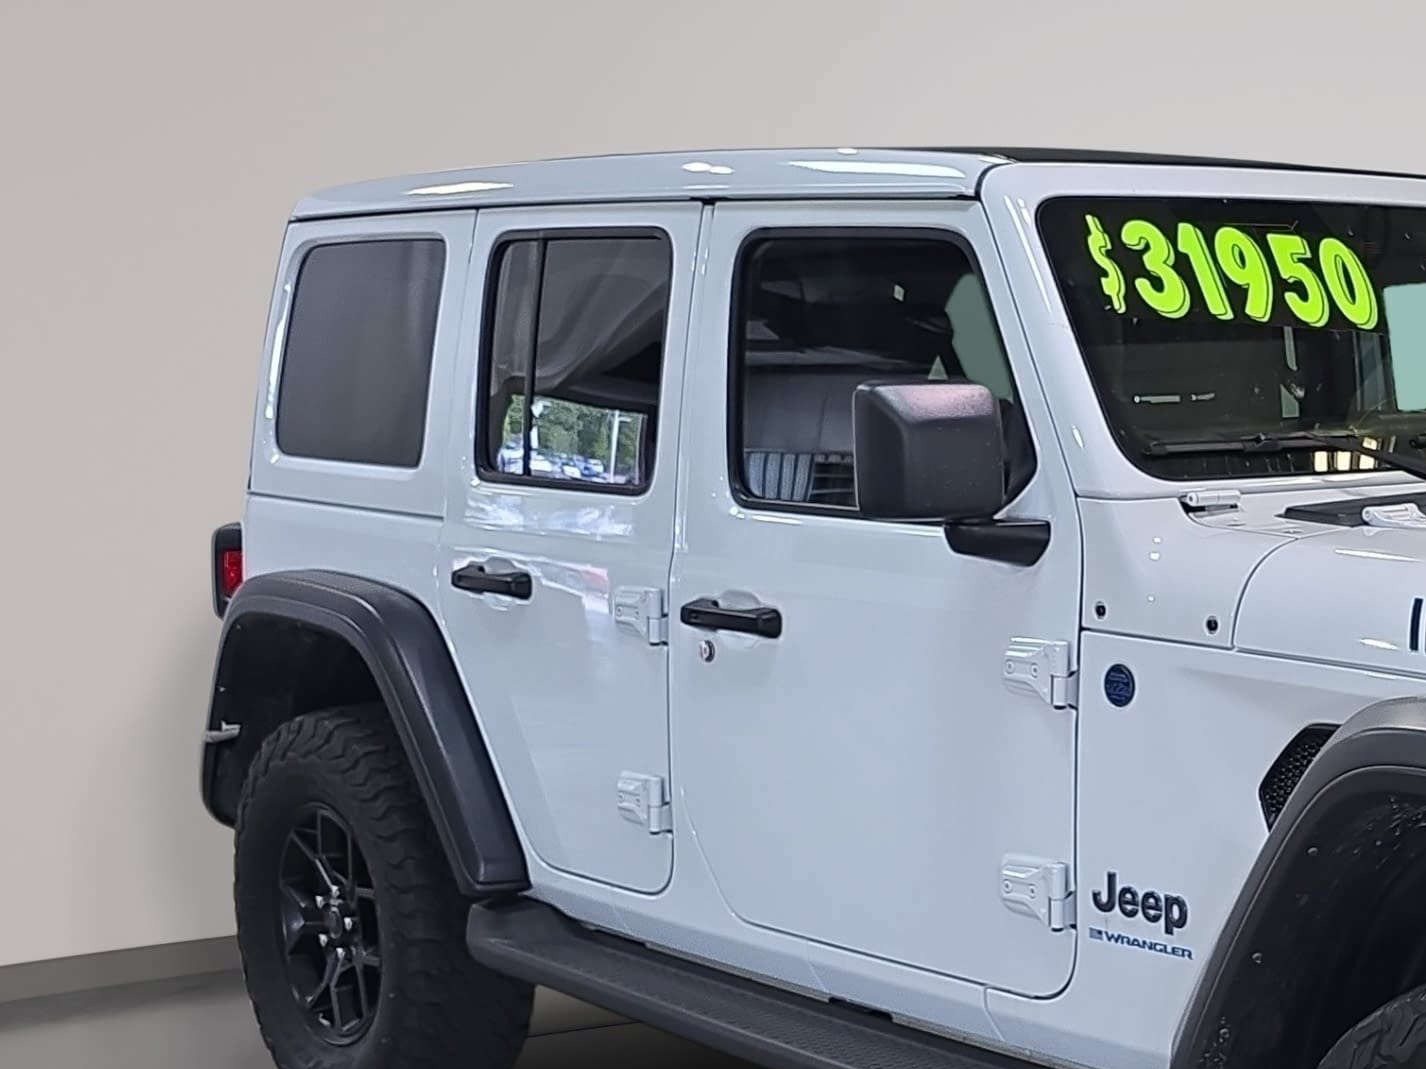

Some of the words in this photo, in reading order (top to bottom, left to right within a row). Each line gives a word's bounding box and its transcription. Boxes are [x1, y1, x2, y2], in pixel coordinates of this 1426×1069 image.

[1085, 214, 1378, 330] $31950
[1091, 871, 1188, 936] Jeep
[1104, 931, 1193, 960] WRANGLER
